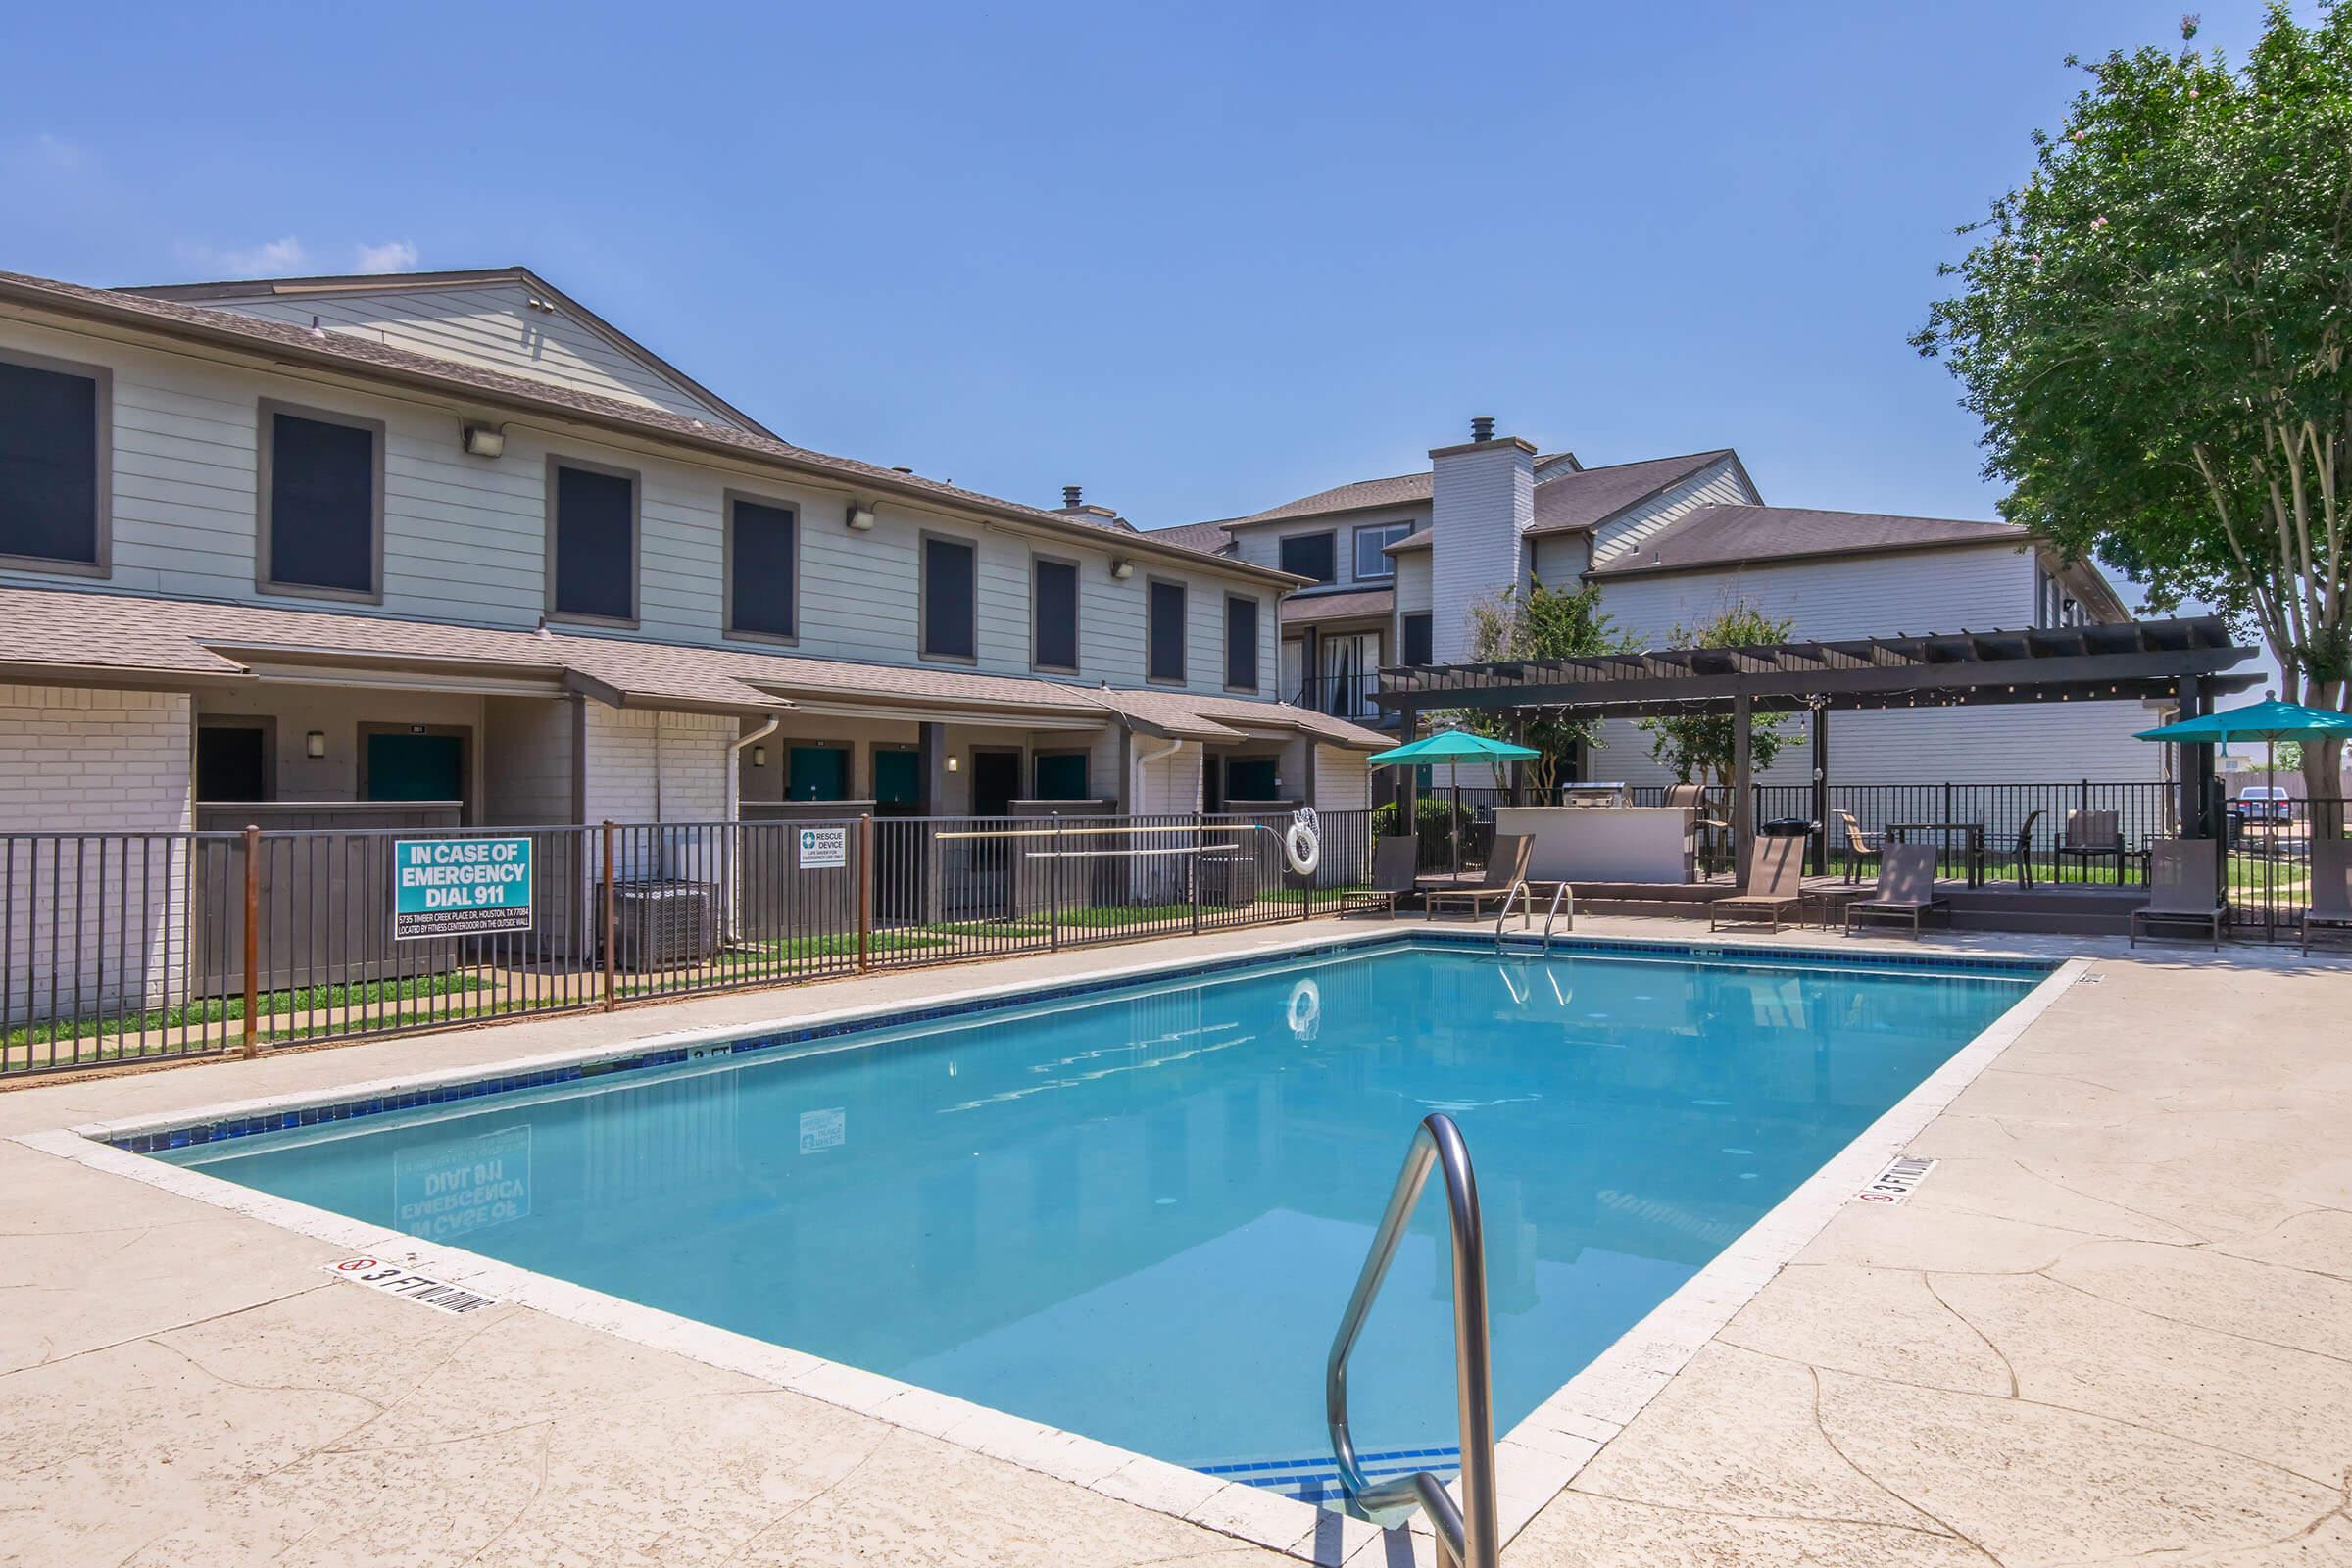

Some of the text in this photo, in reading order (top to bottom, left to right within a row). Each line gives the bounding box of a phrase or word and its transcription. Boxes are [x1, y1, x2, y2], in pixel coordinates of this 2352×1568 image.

[410, 844, 518, 864] IN CASE OF
[402, 863, 525, 887] EMERGENCY
[425, 885, 504, 907] DIAL 911
[414, 914, 433, 924] TIMBER
[434, 912, 452, 921] CREEK
[452, 911, 468, 921] PLACE
[506, 908, 514, 917] TX
[398, 917, 529, 935] LOCATED BY FITNESS CENTER DOOR ON THE OUTSIDE WALL
[1880, 1174, 1918, 1186] FT
[361, 1269, 401, 1281] 3
[380, 1276, 438, 1292] FT
